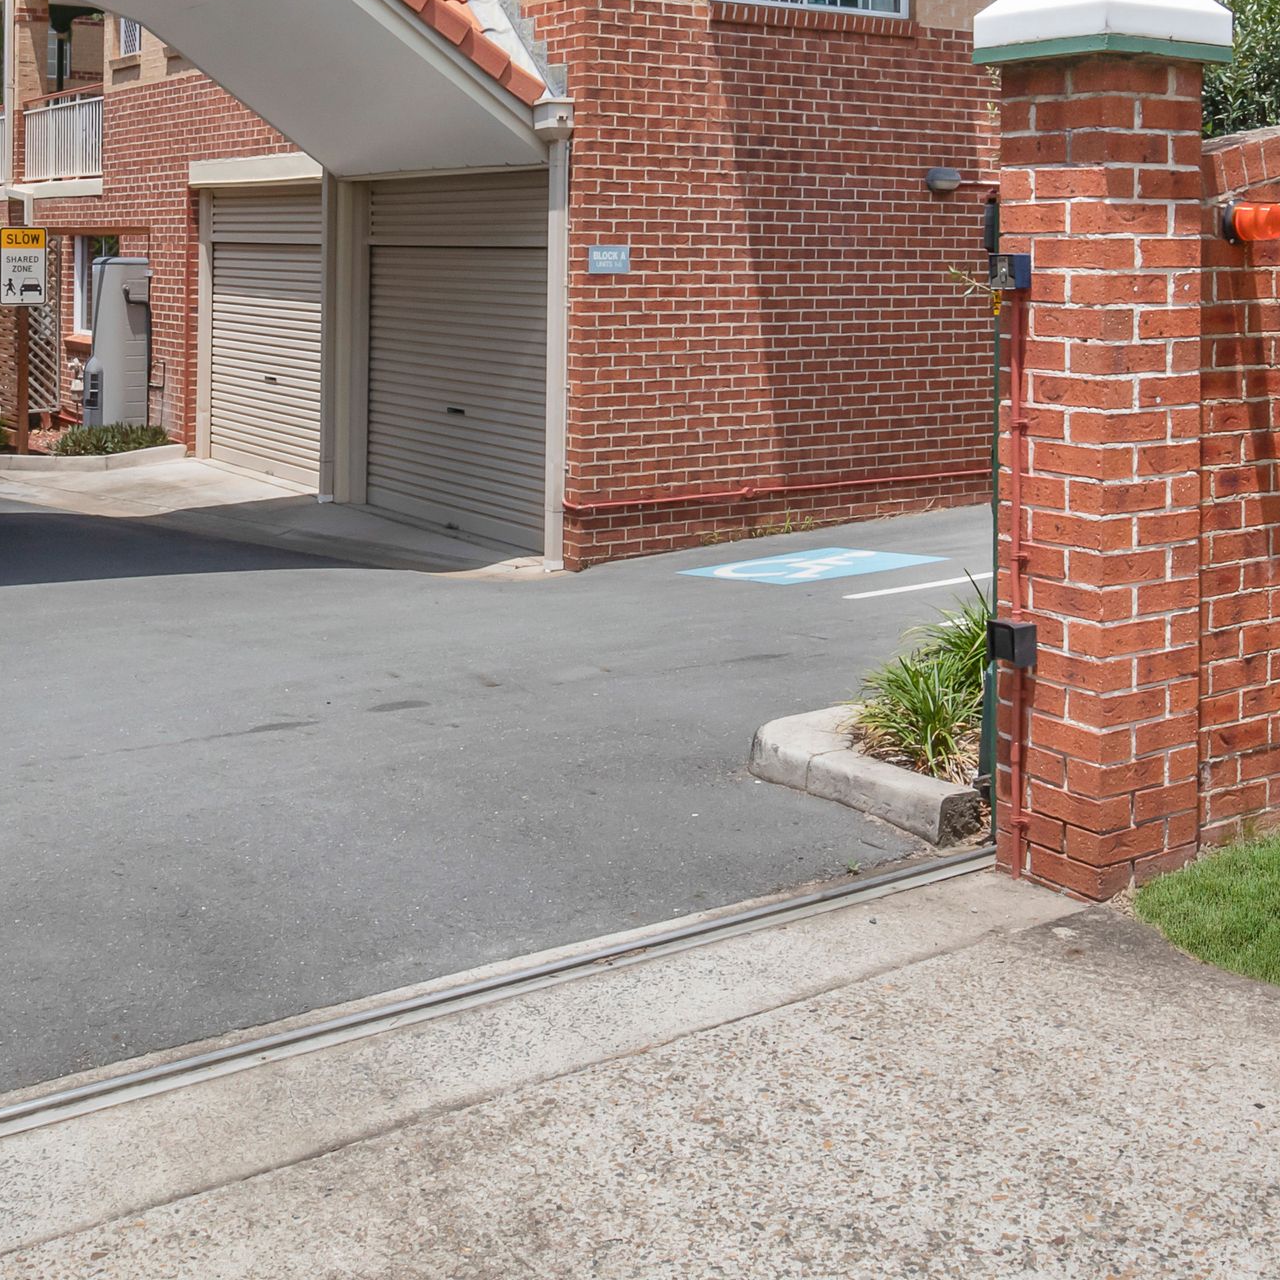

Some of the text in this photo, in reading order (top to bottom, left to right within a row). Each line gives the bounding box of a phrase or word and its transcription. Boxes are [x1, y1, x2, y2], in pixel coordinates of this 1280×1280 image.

[6, 233, 40, 245] SLOW
[6, 255, 39, 263] SHARED
[593, 251, 626, 260] BLOCK A
[11, 265, 33, 273] ZONE
